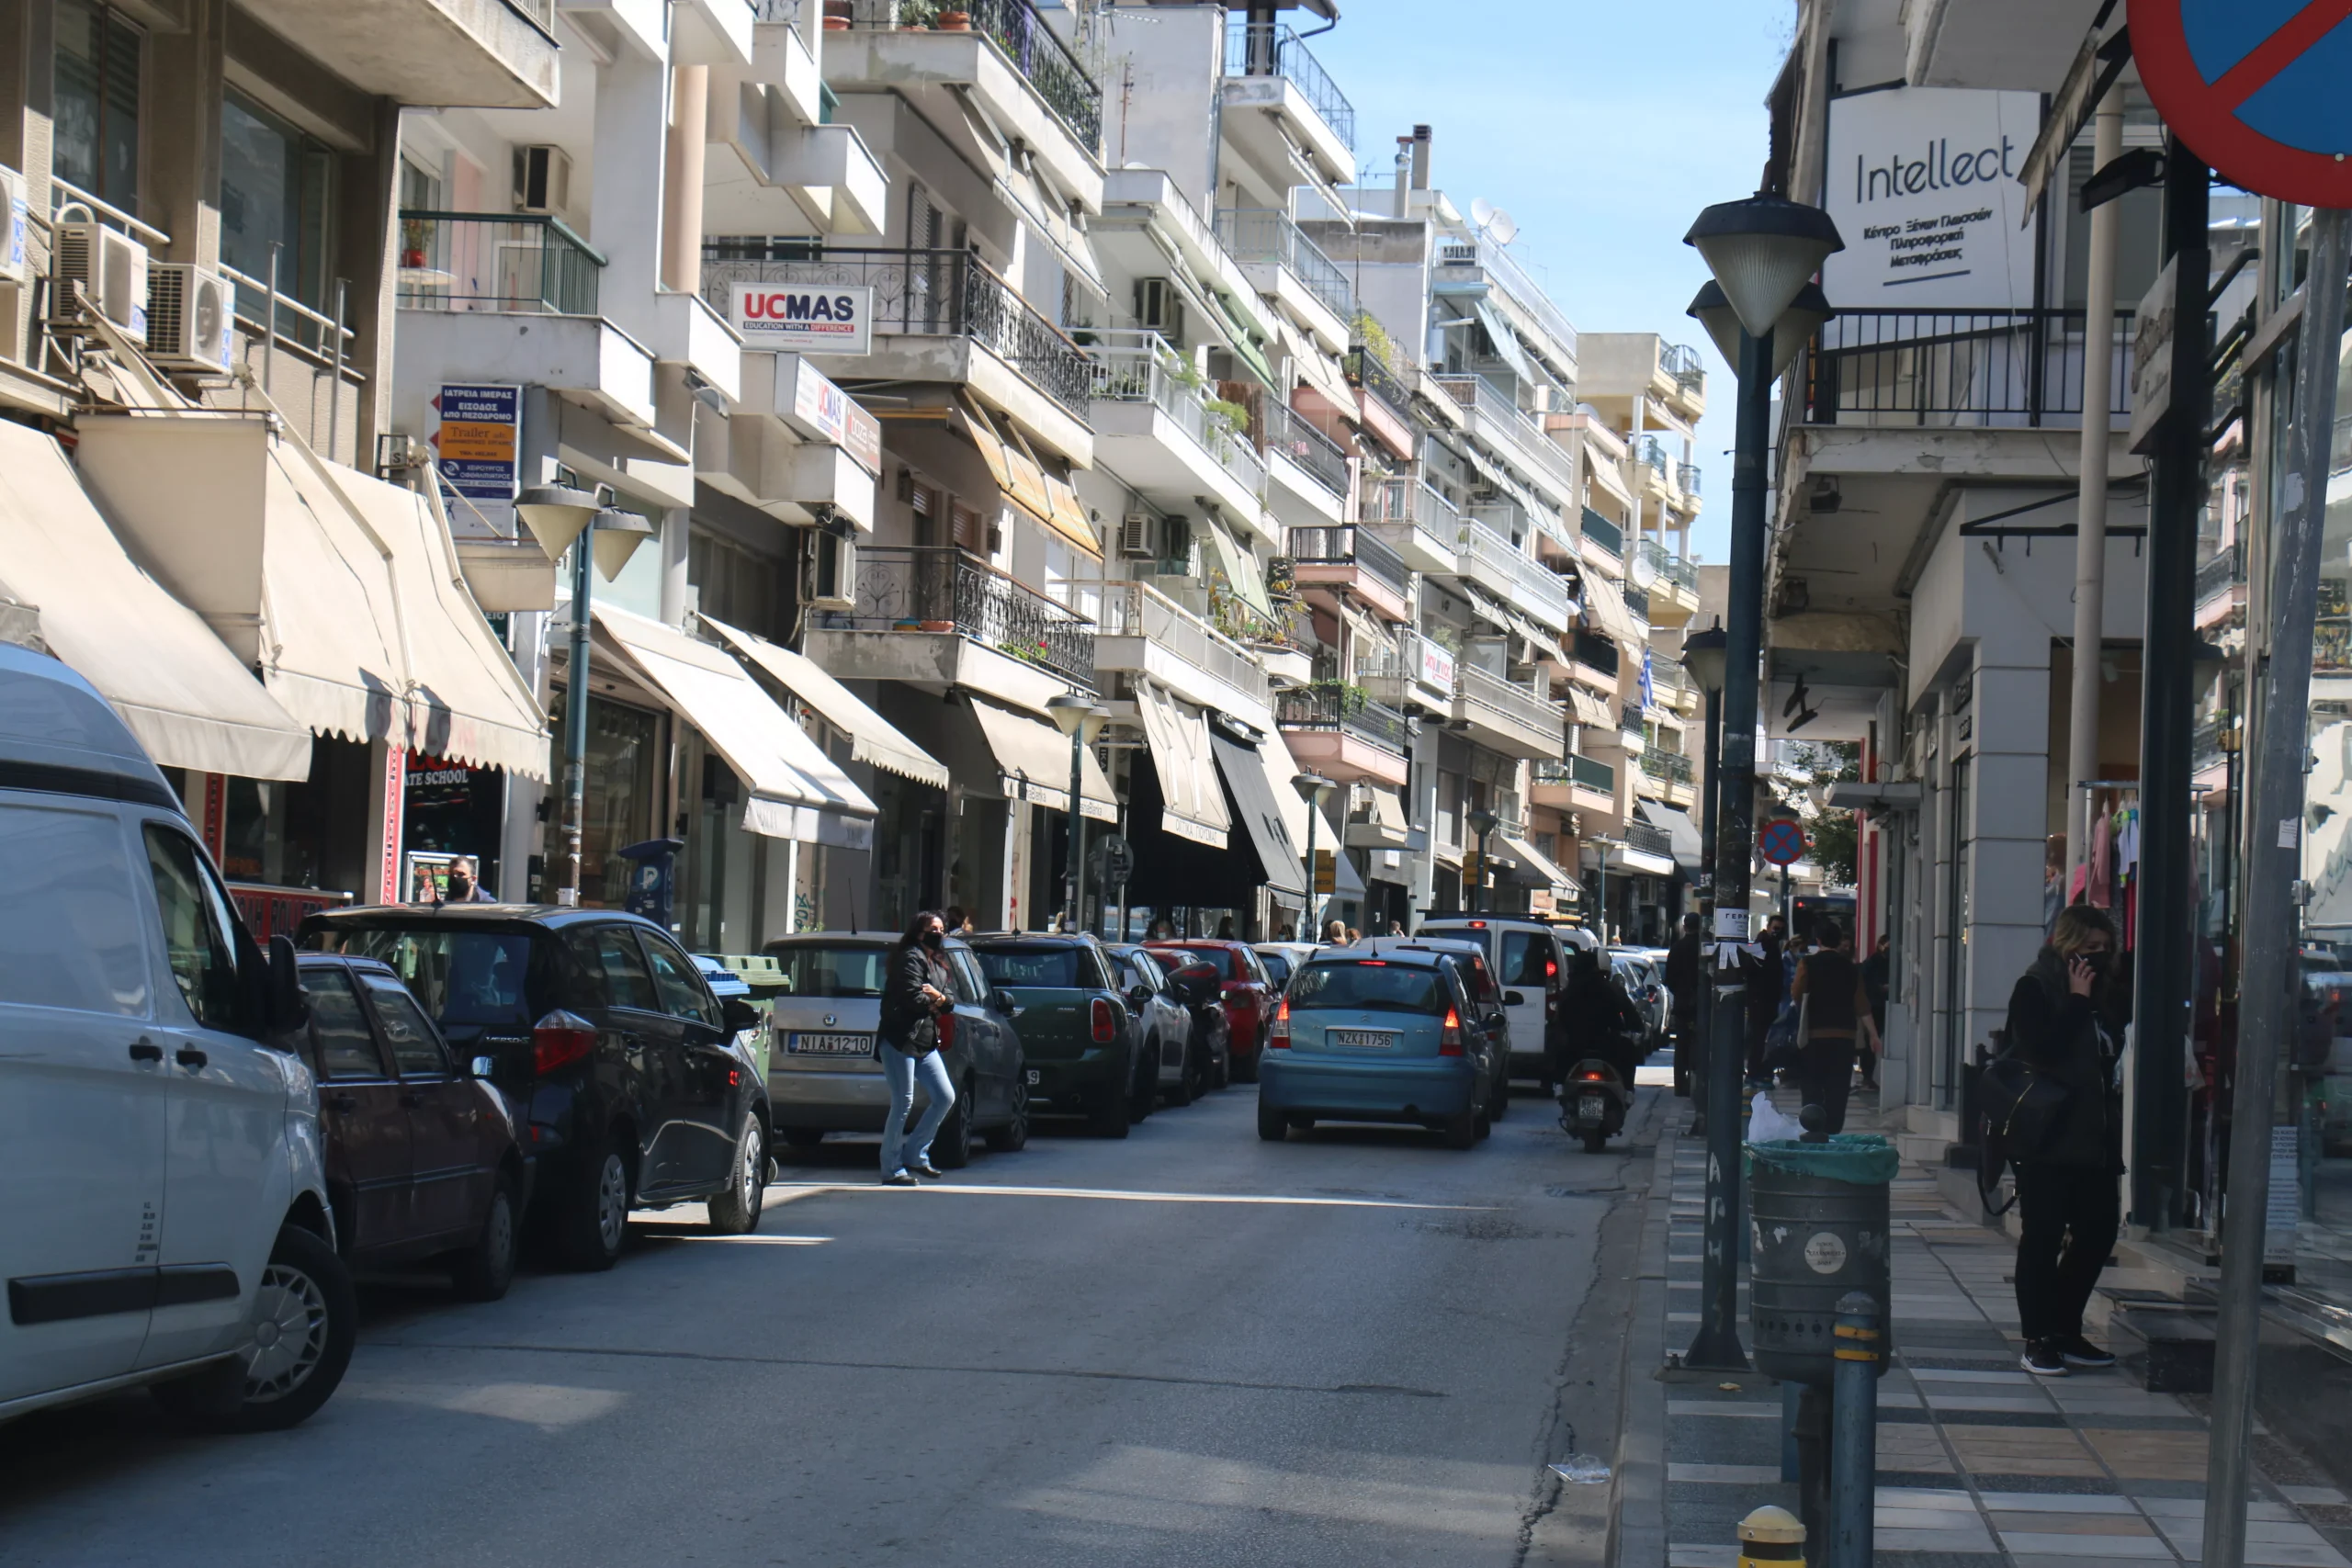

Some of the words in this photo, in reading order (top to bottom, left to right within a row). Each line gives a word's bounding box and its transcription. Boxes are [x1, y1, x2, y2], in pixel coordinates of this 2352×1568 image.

[1857, 135, 2014, 204] Intellect
[1863, 223, 1901, 240] Κέντρο
[1906, 218, 1939, 232] Ξένων
[1940, 208, 1993, 227] Γλωσσών
[1890, 227, 1964, 251] Πληροφορική
[1890, 247, 1962, 268] Μεταφράσεις
[744, 293, 854, 321] UCMAS
[745, 321, 783, 330] EDUCATION
[810, 323, 853, 332] DIFFERENCE
[445, 389, 478, 398] ΙΑΤΡΕΙΑ
[458, 402, 498, 412] ΕΙΣΟΔΟΣ
[443, 411, 460, 419] ΑΠΟ
[462, 412, 512, 421] ΠΕΖΟΔΡΟΜΟ
[450, 426, 490, 438] Trailer
[424, 769, 469, 785] SCHOOL
